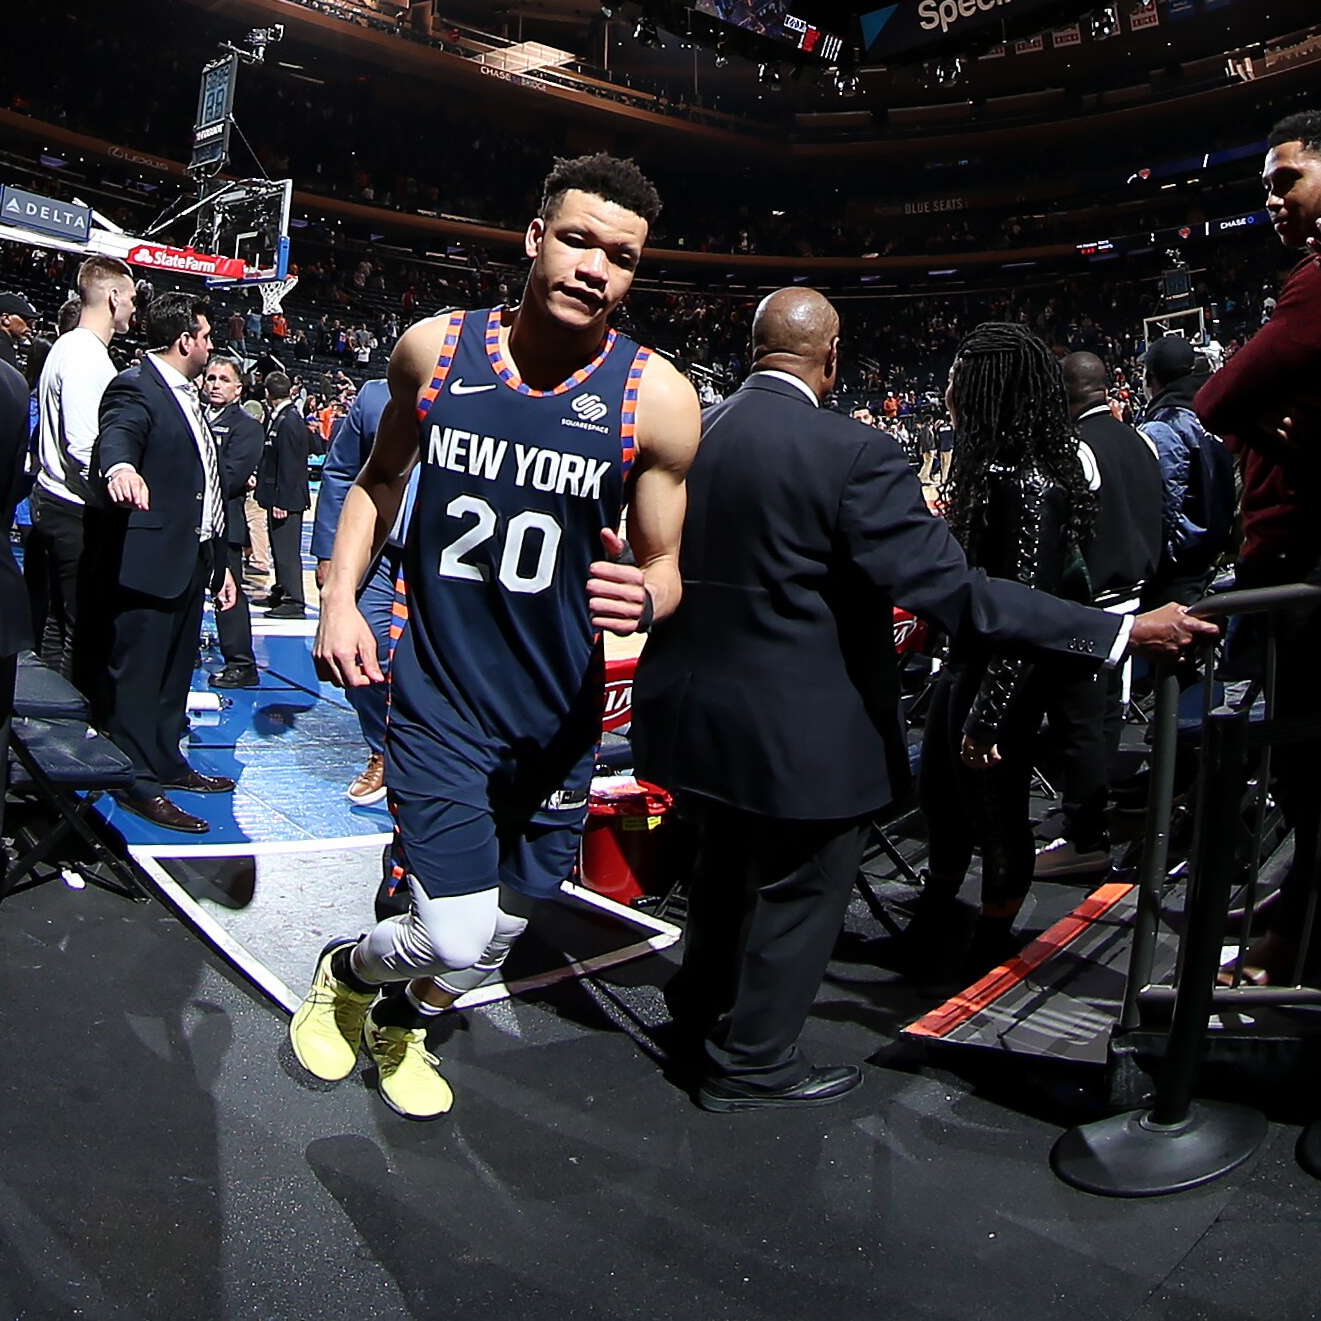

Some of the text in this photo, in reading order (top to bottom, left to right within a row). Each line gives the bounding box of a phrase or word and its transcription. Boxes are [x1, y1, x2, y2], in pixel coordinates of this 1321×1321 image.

[480, 66, 512, 81] CHASE
[125, 153, 169, 171] LEXUS
[25, 201, 87, 230] DELTA
[904, 198, 964, 215] BLUE SEATS
[560, 417, 610, 435] SQUARESPACE
[427, 424, 612, 500] NEW YORK
[439, 493, 563, 595] 20
[604, 686, 633, 713] IA
